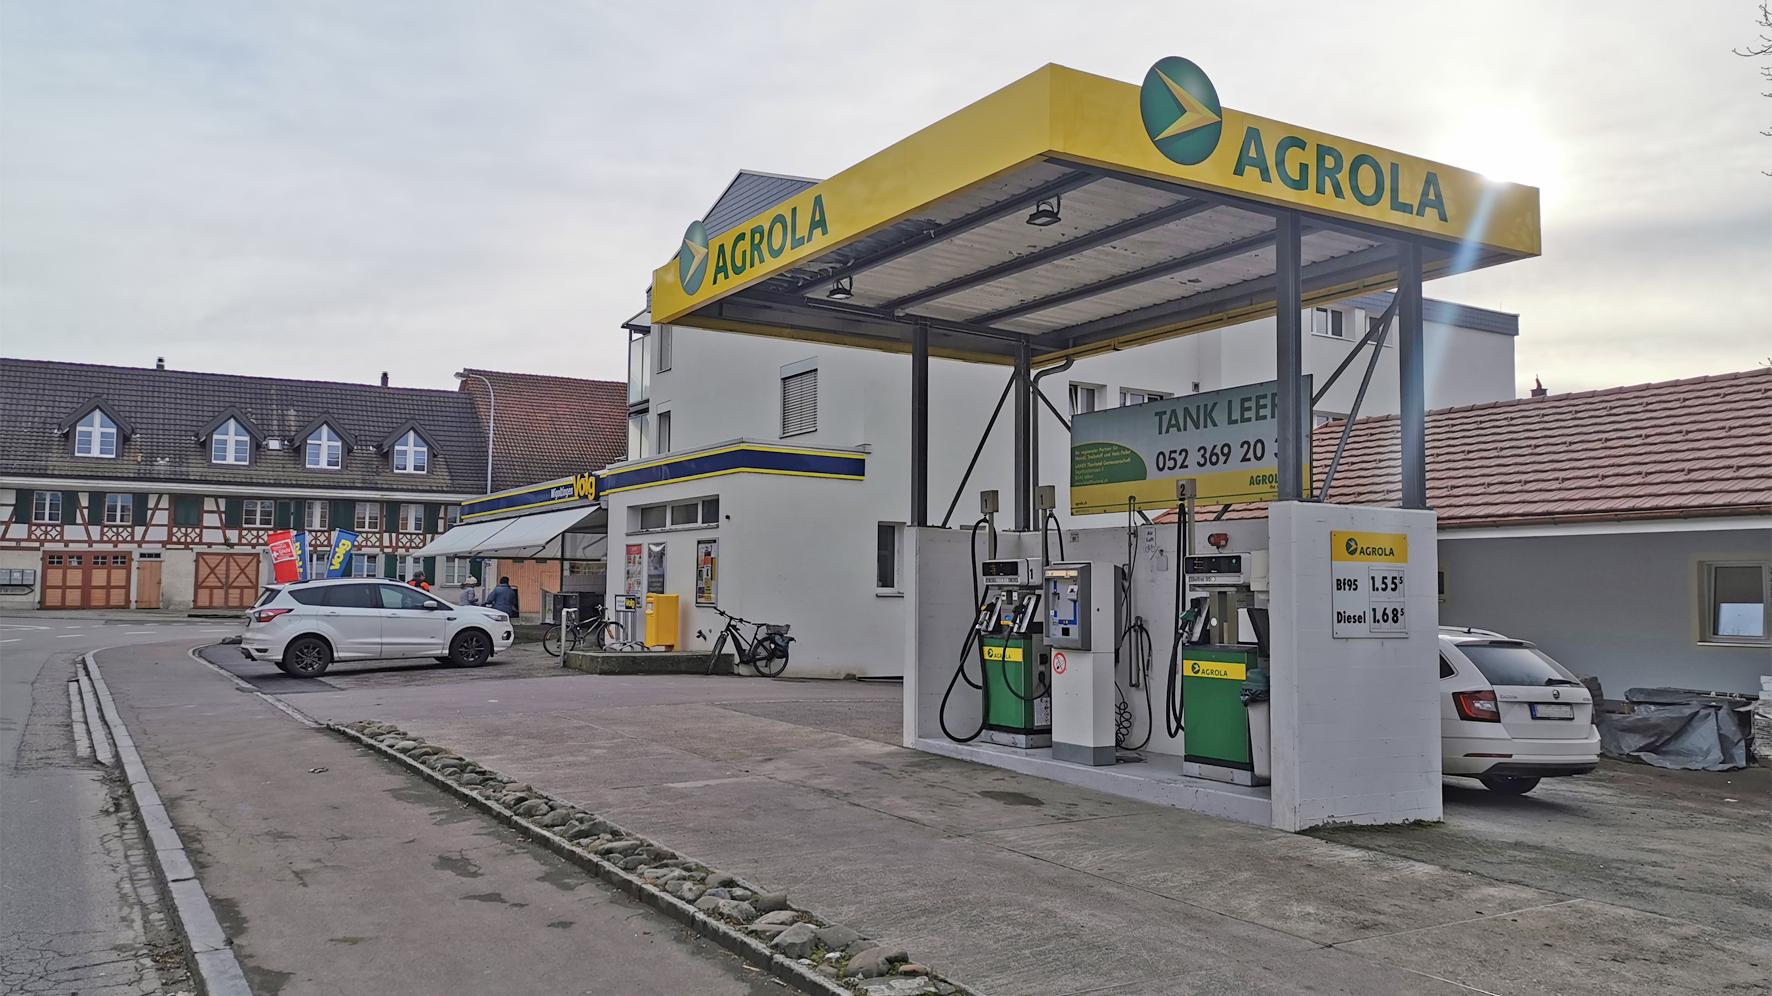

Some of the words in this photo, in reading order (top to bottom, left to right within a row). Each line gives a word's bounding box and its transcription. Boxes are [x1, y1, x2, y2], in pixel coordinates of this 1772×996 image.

[1233, 126, 1449, 223] AGROLA
[712, 194, 829, 285] AGROLA
[1154, 401, 1219, 435] TANK
[1156, 448, 1189, 472] 052
[1196, 442, 1232, 468] 369
[1240, 438, 1266, 463] 20
[572, 471, 596, 501] Volg
[1249, 473, 1279, 486] AGROL
[1180, 484, 1186, 497] 2
[1359, 546, 1395, 557] AGROLA
[1029, 568, 1034, 580] 1
[1335, 578, 1359, 591] Bf95
[1336, 610, 1366, 624] Diesel
[993, 652, 1011, 660] AGRLA
[1200, 668, 1228, 677] AGROLA
